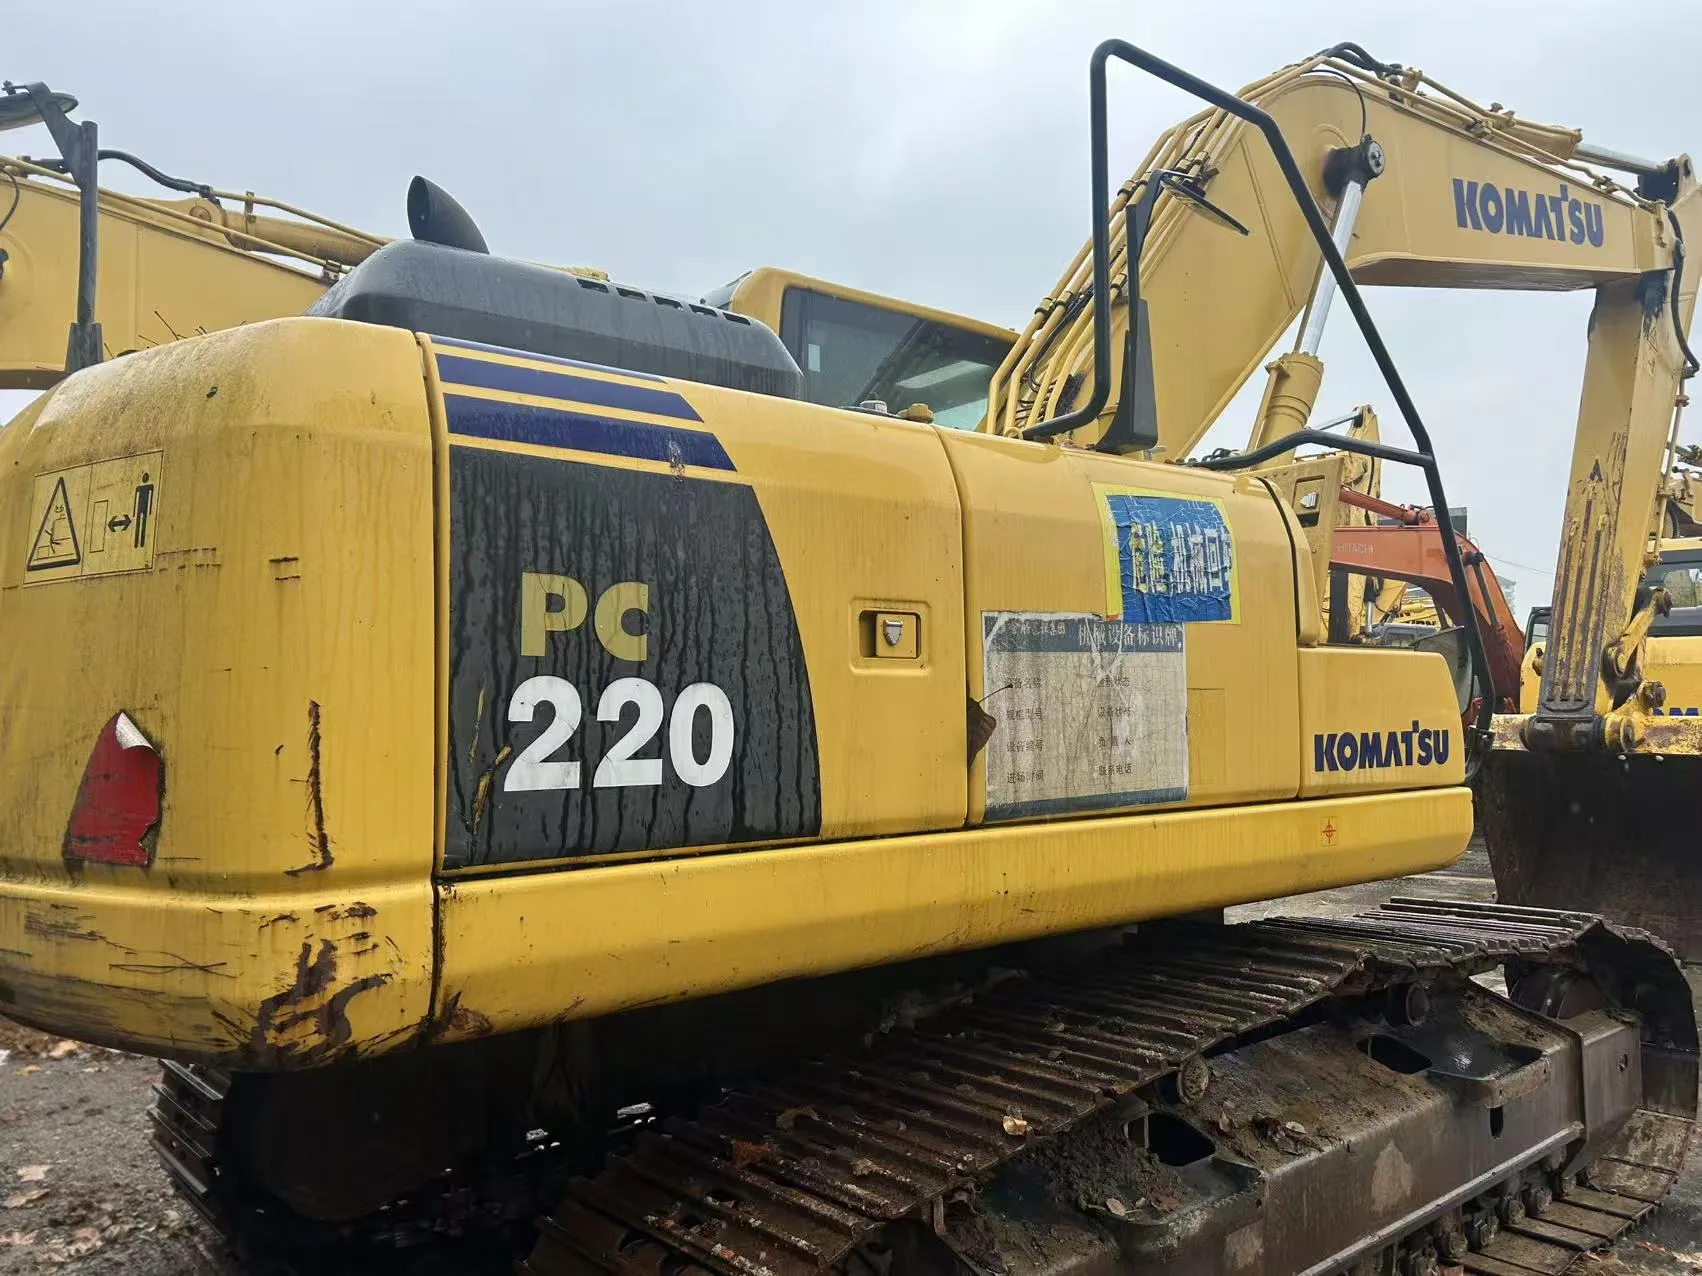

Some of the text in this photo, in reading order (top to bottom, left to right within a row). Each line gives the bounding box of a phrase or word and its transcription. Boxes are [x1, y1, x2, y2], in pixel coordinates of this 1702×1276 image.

[1452, 178, 1604, 248] KOMATSU
[1337, 544, 1375, 556] HITACHI
[520, 571, 649, 661] PC
[1077, 623, 1179, 647] 机械设备标识牌
[503, 675, 735, 792] 220
[1314, 720, 1450, 772] KOMATSU
[1098, 763, 1132, 776] 联系电话
